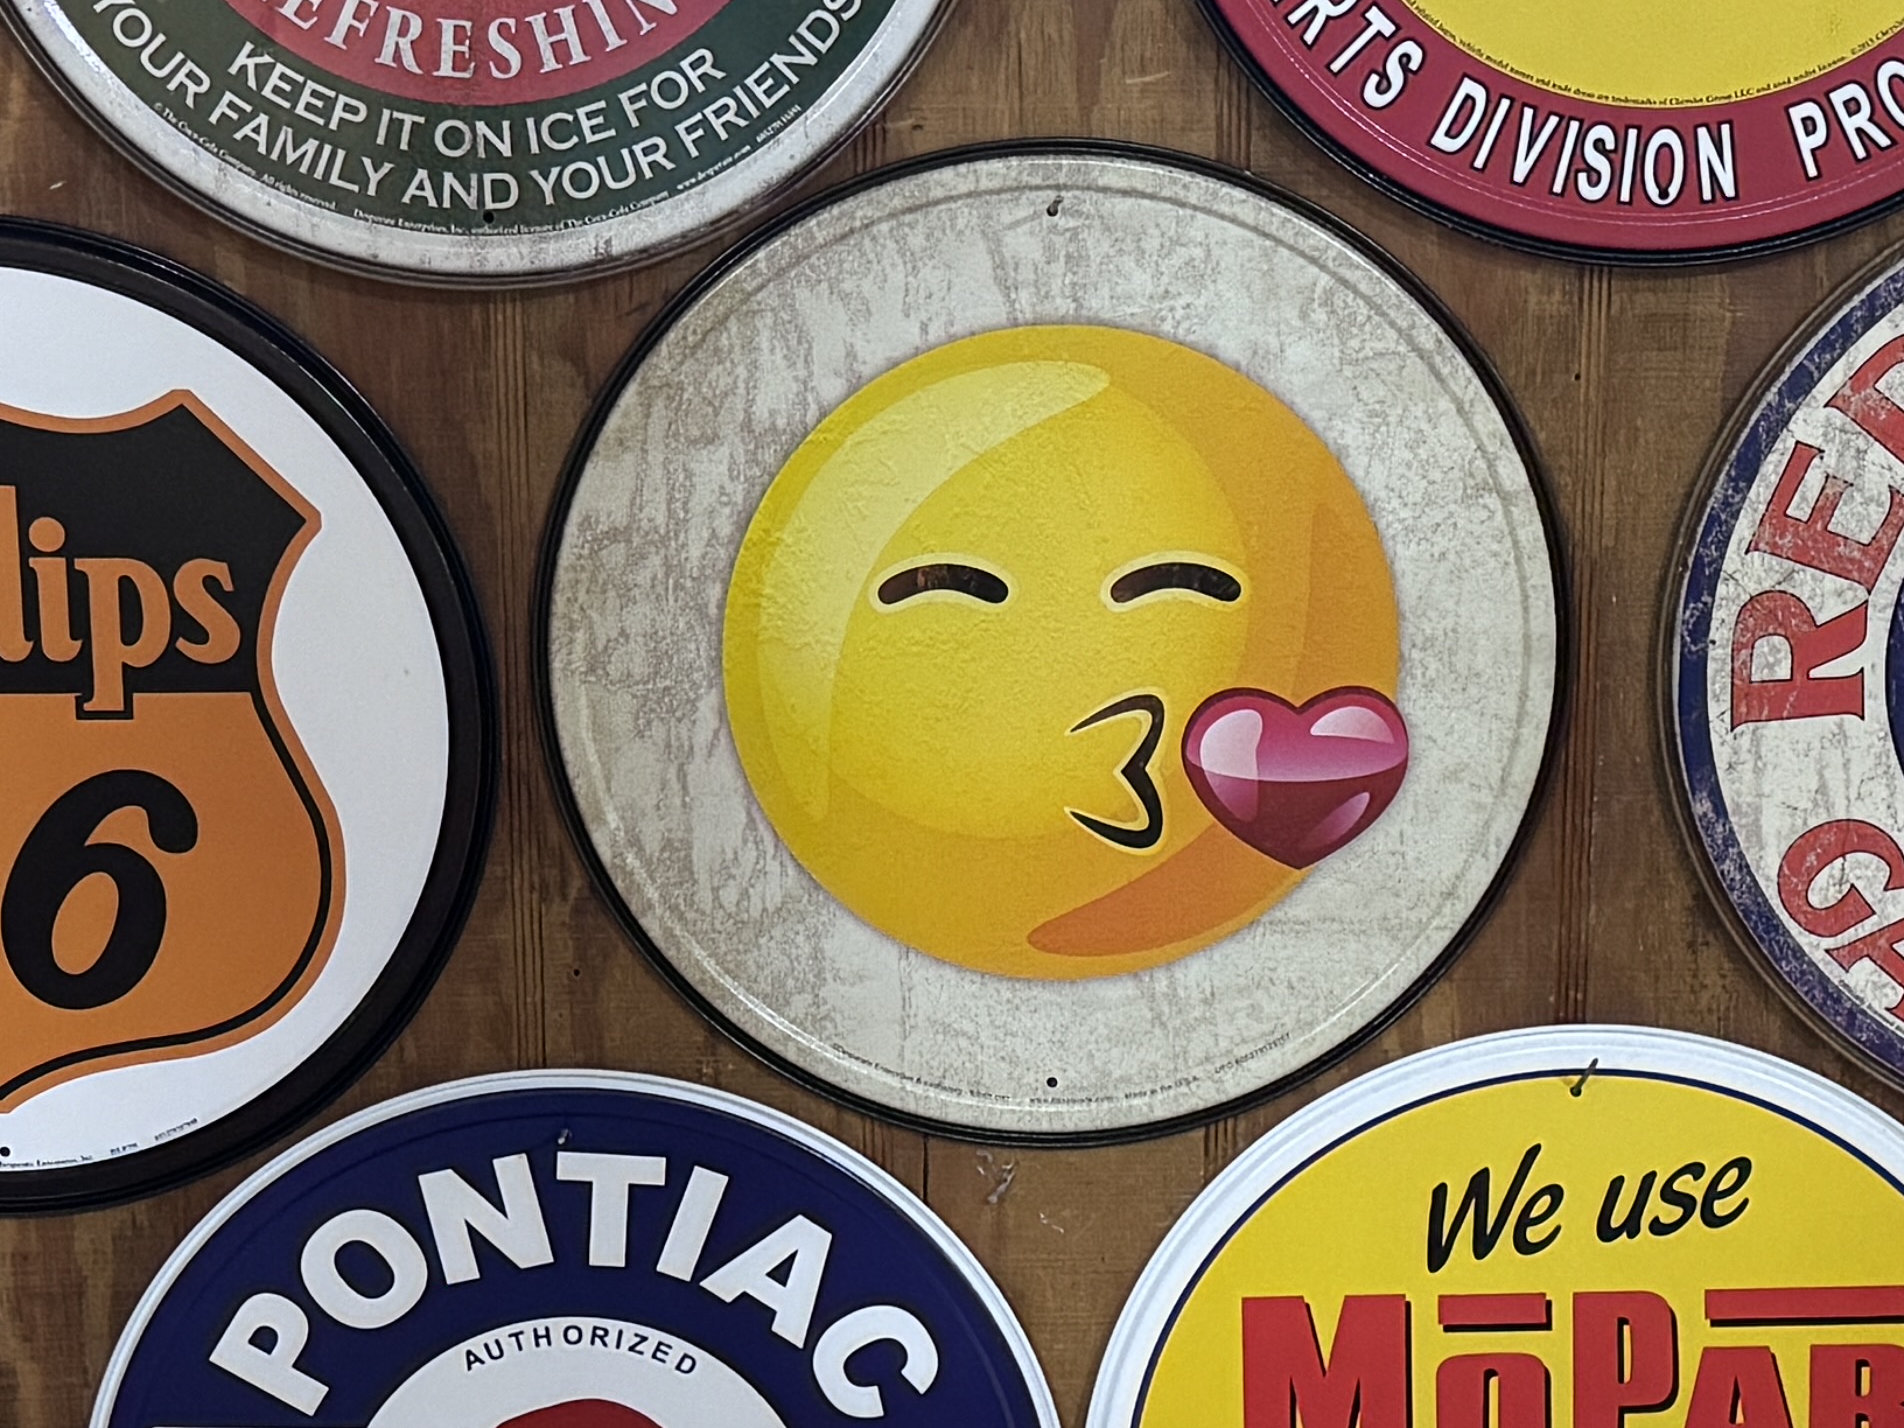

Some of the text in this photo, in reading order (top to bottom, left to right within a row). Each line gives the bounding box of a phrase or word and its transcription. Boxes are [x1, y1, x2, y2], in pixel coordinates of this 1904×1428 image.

[210, 95, 406, 199] FAMILY
[401, 168, 520, 211] AND
[529, 136, 677, 209] YOUR
[228, 40, 368, 134] KEEP
[376, 98, 425, 150] IT
[434, 120, 513, 159] ON
[528, 100, 618, 155] ICE
[615, 45, 728, 132] FOR
[1429, 76, 1737, 206] DIVISION
[1426, 1143, 1754, 1274] We use
[208, 1151, 940, 1420] PONTIAC
[462, 1325, 699, 1377] AUTHORIZED
